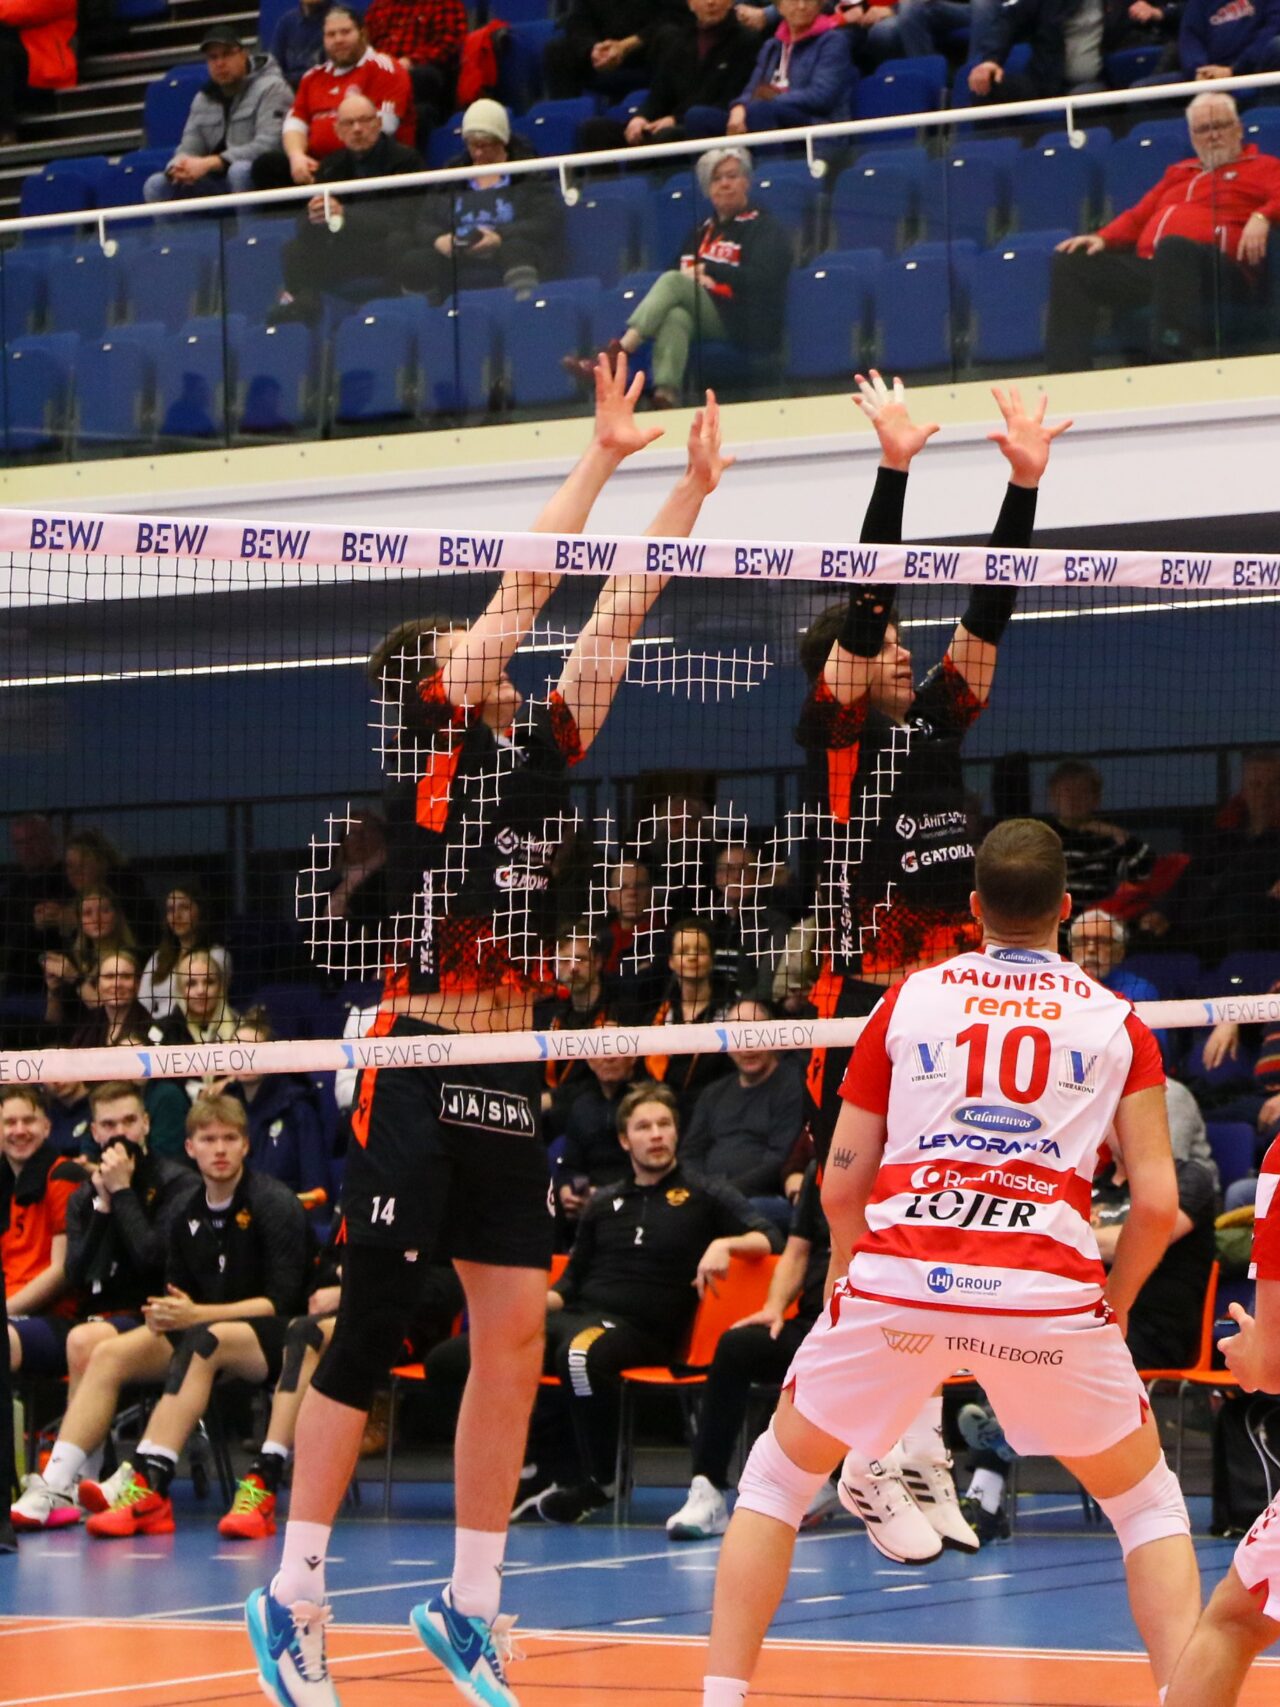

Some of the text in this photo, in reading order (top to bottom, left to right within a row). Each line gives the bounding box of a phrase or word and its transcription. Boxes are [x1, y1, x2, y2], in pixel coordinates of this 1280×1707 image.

[30, 518, 104, 552] BEWI
[136, 523, 208, 555] BEWI
[240, 528, 310, 560] BEWI
[341, 532, 408, 563] BEWI
[438, 536, 503, 567] BEWI
[555, 540, 617, 571] BEWI
[646, 543, 706, 573] BEWI
[734, 547, 793, 576] BEWI
[820, 550, 878, 578] BEWI
[904, 551, 960, 579] BEWI
[985, 554, 1039, 582] BEWI
[1064, 557, 1118, 583] BEWI
[1160, 559, 1212, 585] BEWI
[941, 968, 1091, 999] KAUNISTO
[964, 996, 1062, 1021] renta
[15, 1059, 44, 1082] OY
[156, 1050, 224, 1075] VEXVE
[229, 1049, 257, 1072] OY
[359, 1043, 426, 1067] VEXVE
[427, 1040, 453, 1064] OY
[551, 1035, 610, 1057] VEXVE
[616, 1034, 640, 1056] OY
[731, 1027, 788, 1049] VEXVE
[793, 1026, 814, 1047] OY
[1216, 1002, 1265, 1024] VEXVE
[955, 1023, 1051, 1104] 10
[963, 1110, 1034, 1129] Kalaneuvos
[371, 1195, 396, 1226] 14
[905, 1190, 1037, 1228] LOJER
[634, 1226, 644, 1244] 2
[929, 1274, 1002, 1291] LHJ GROUP
[945, 1336, 1064, 1366] TRELLEBORG
